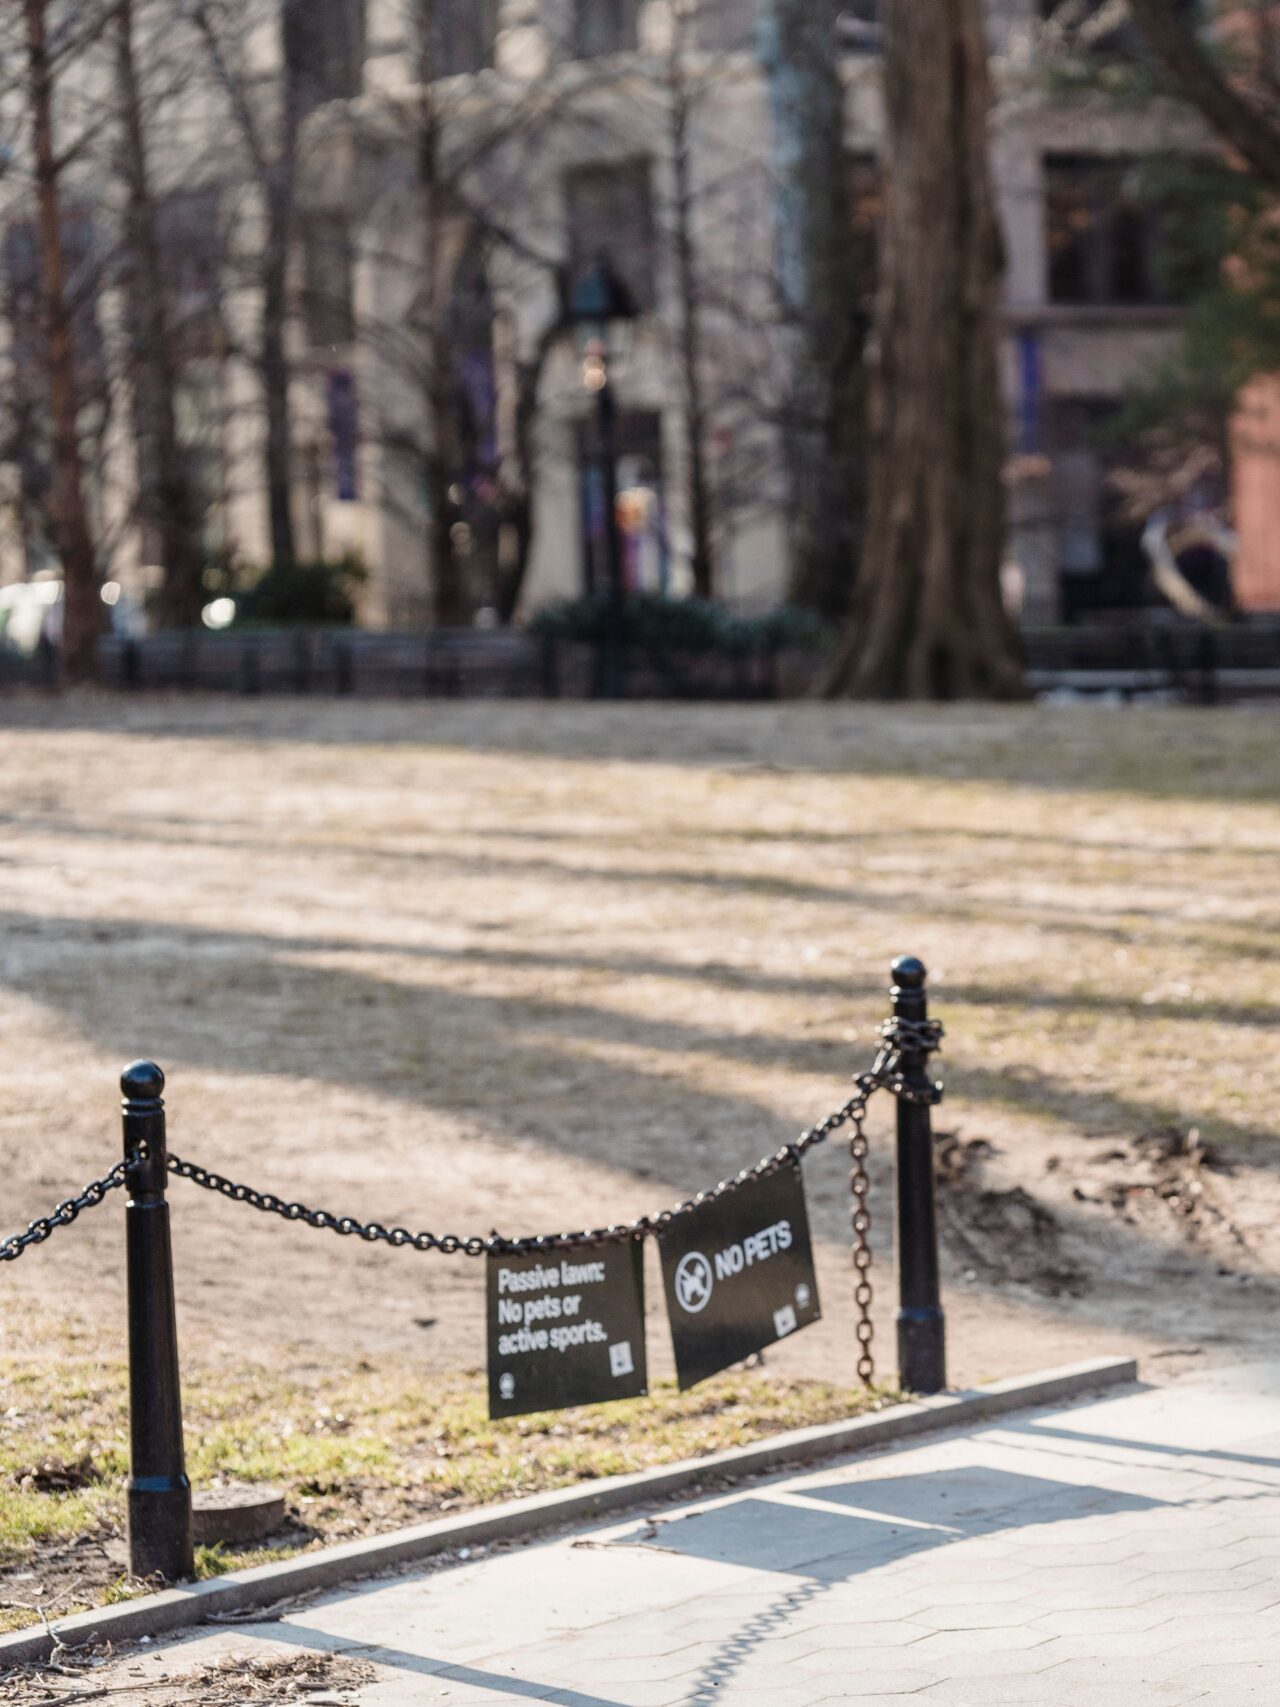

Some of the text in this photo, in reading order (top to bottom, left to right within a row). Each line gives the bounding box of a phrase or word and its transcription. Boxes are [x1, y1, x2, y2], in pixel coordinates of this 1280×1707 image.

[714, 1220, 792, 1280] NO PETS
[498, 1264, 558, 1293] Passive
[498, 1295, 581, 1326] No pets or
[498, 1319, 607, 1355] active sports.
